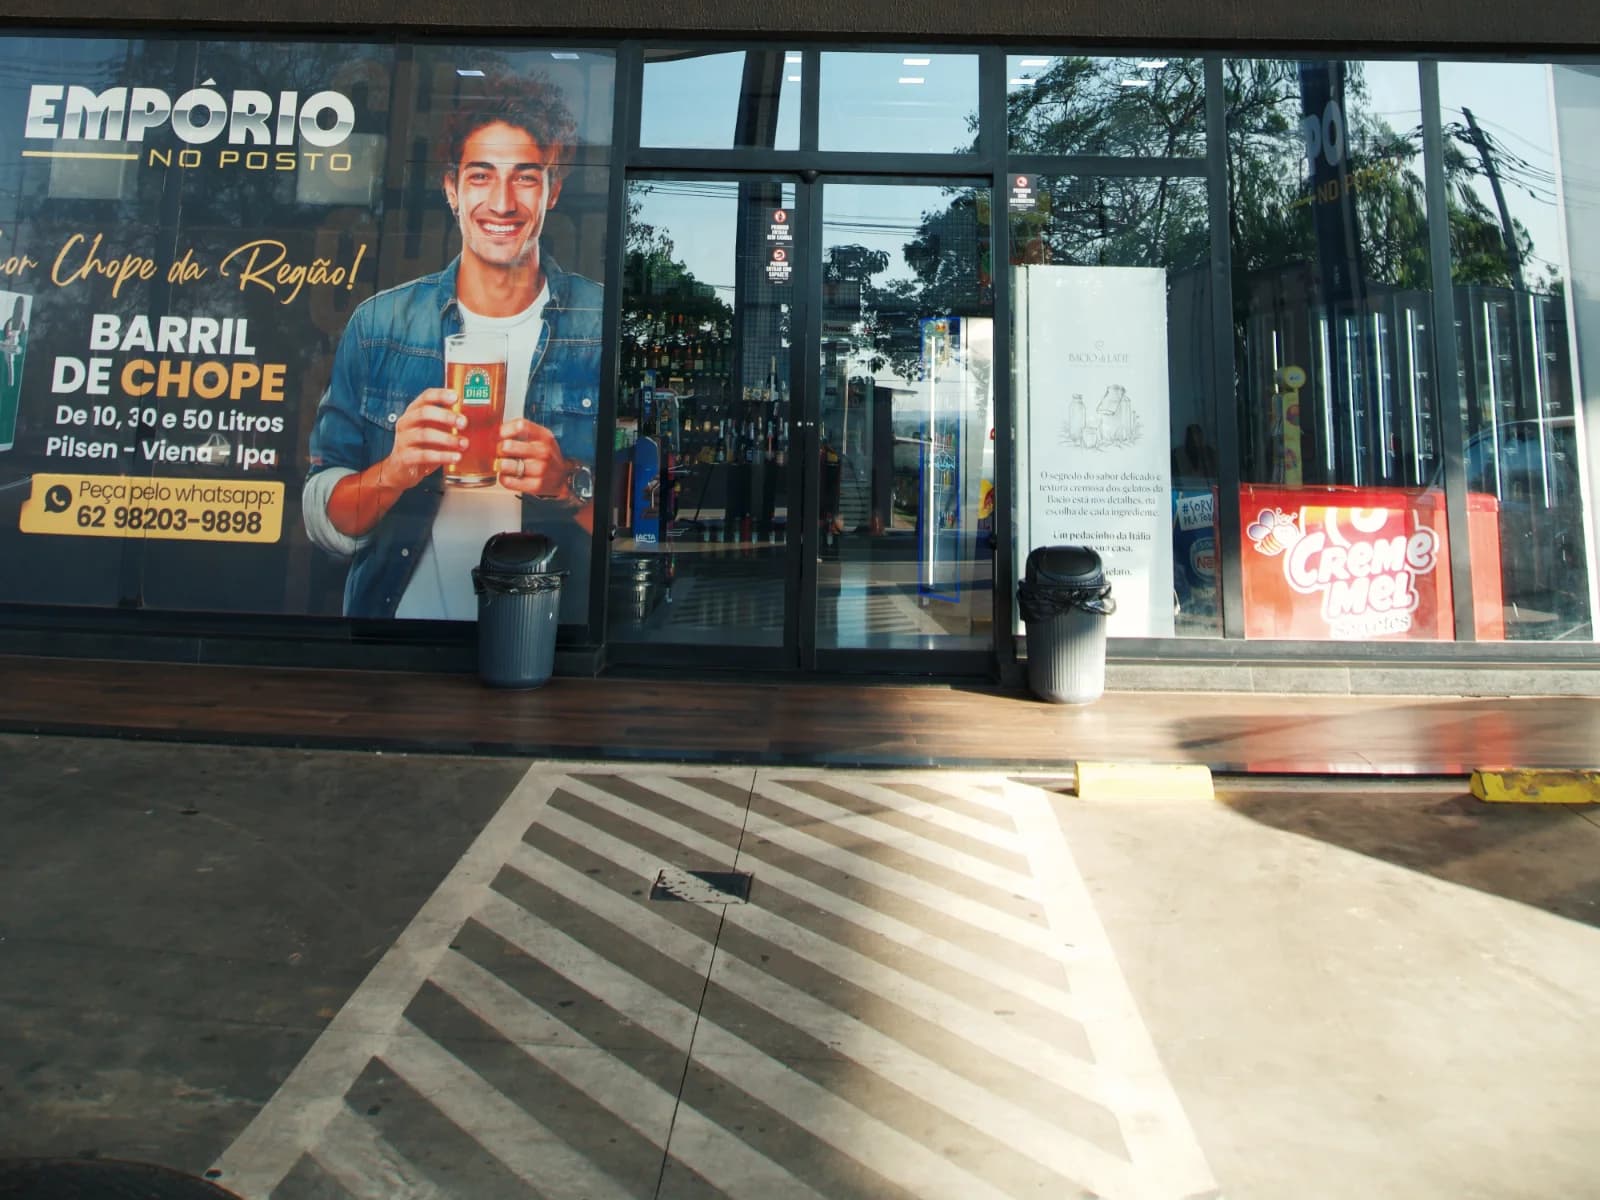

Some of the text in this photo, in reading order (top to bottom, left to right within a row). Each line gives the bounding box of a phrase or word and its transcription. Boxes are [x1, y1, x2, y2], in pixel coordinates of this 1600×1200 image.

[24, 77, 356, 148] EMPÓRIO
[149, 148, 352, 172] NO POSTO
[52, 232, 158, 298] Chope
[167, 248, 207, 285] da
[220, 239, 367, 305] Região!
[90, 313, 256, 356] BARRIL
[51, 356, 287, 402] DE CHOPE
[55, 404, 284, 433] De 10, 30 e 50 Litros
[46, 435, 118, 459] Pilsen
[142, 439, 213, 463] Viena
[236, 444, 276, 471] Ipa
[1039, 483, 1164, 495] textura cremosa dos gelatos da
[1040, 471, 1048, 480] O
[1049, 471, 1081, 482] segredo
[1083, 471, 1095, 481] do
[1095, 471, 1119, 481] sabor
[1120, 471, 1155, 482] delicado
[79, 480, 275, 510] Peça pelo whatsapp:
[1072, 494, 1089, 504] está
[77, 504, 262, 535] 62 98203-9898
[1045, 507, 1077, 516] escolha
[1077, 507, 1089, 516] de
[1089, 507, 1110, 516] cada
[1069, 530, 1115, 542] pedacinho
[1116, 531, 1128, 541] da
[1128, 531, 1151, 541] Itália
[1111, 545, 1134, 553] casa.
